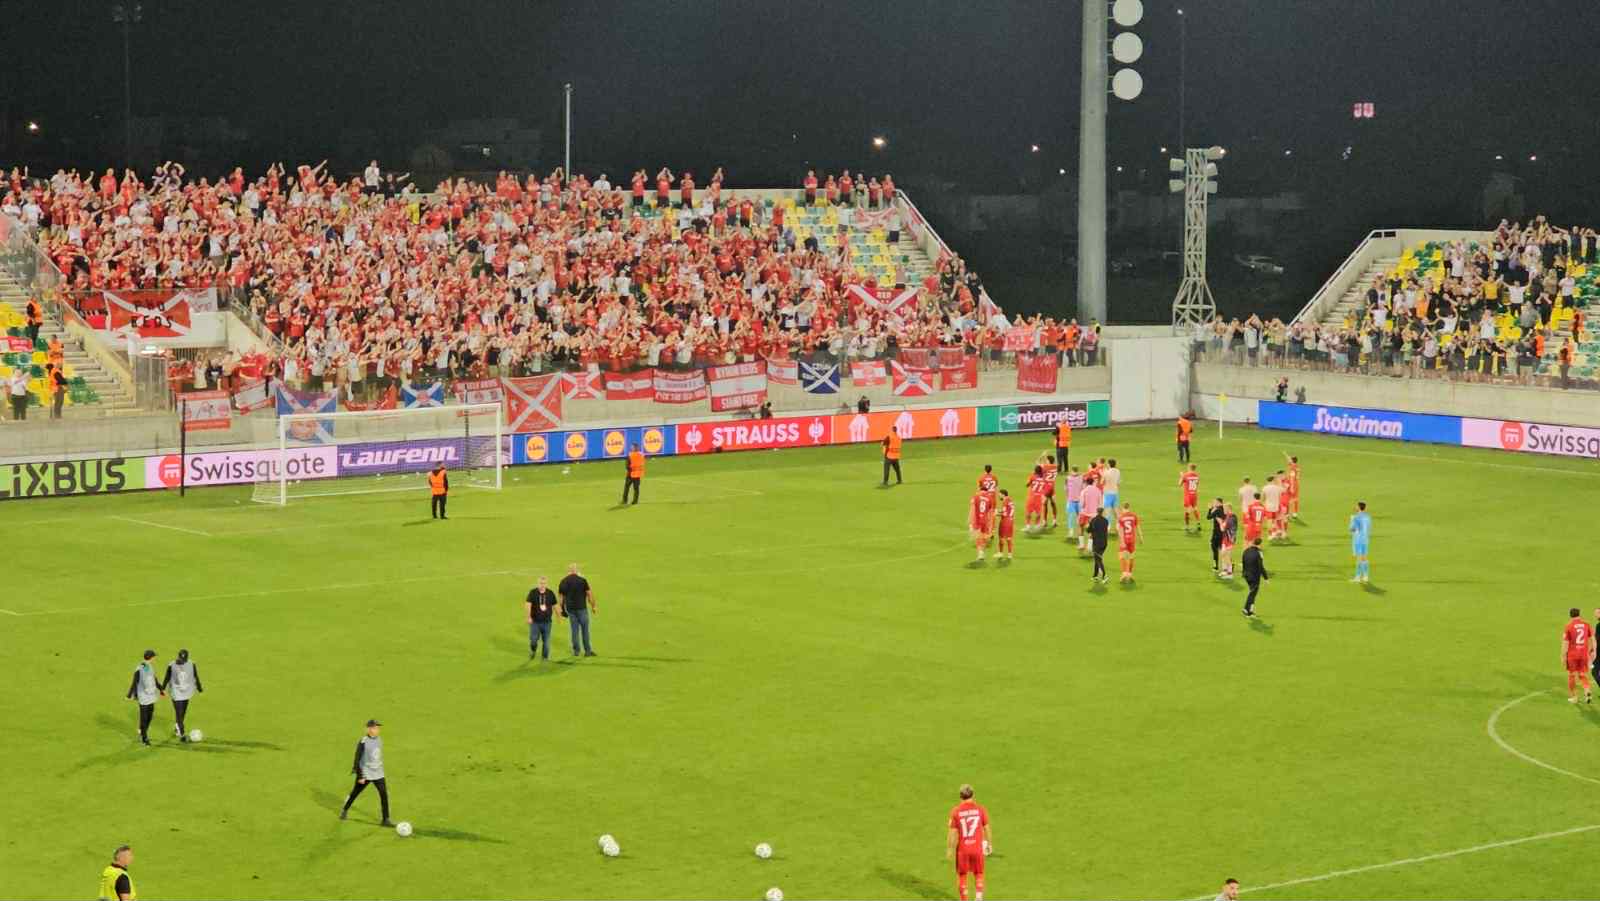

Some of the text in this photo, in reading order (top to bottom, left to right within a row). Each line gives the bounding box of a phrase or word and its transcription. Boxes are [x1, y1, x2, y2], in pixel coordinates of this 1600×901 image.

[1005, 407, 1086, 426] enterprise
[1312, 407, 1403, 437] Stoiximan
[712, 422, 800, 447] STRAUSS
[190, 453, 325, 482] Swissquote
[1575, 628, 1585, 645] 2
[959, 815, 980, 838] 17
